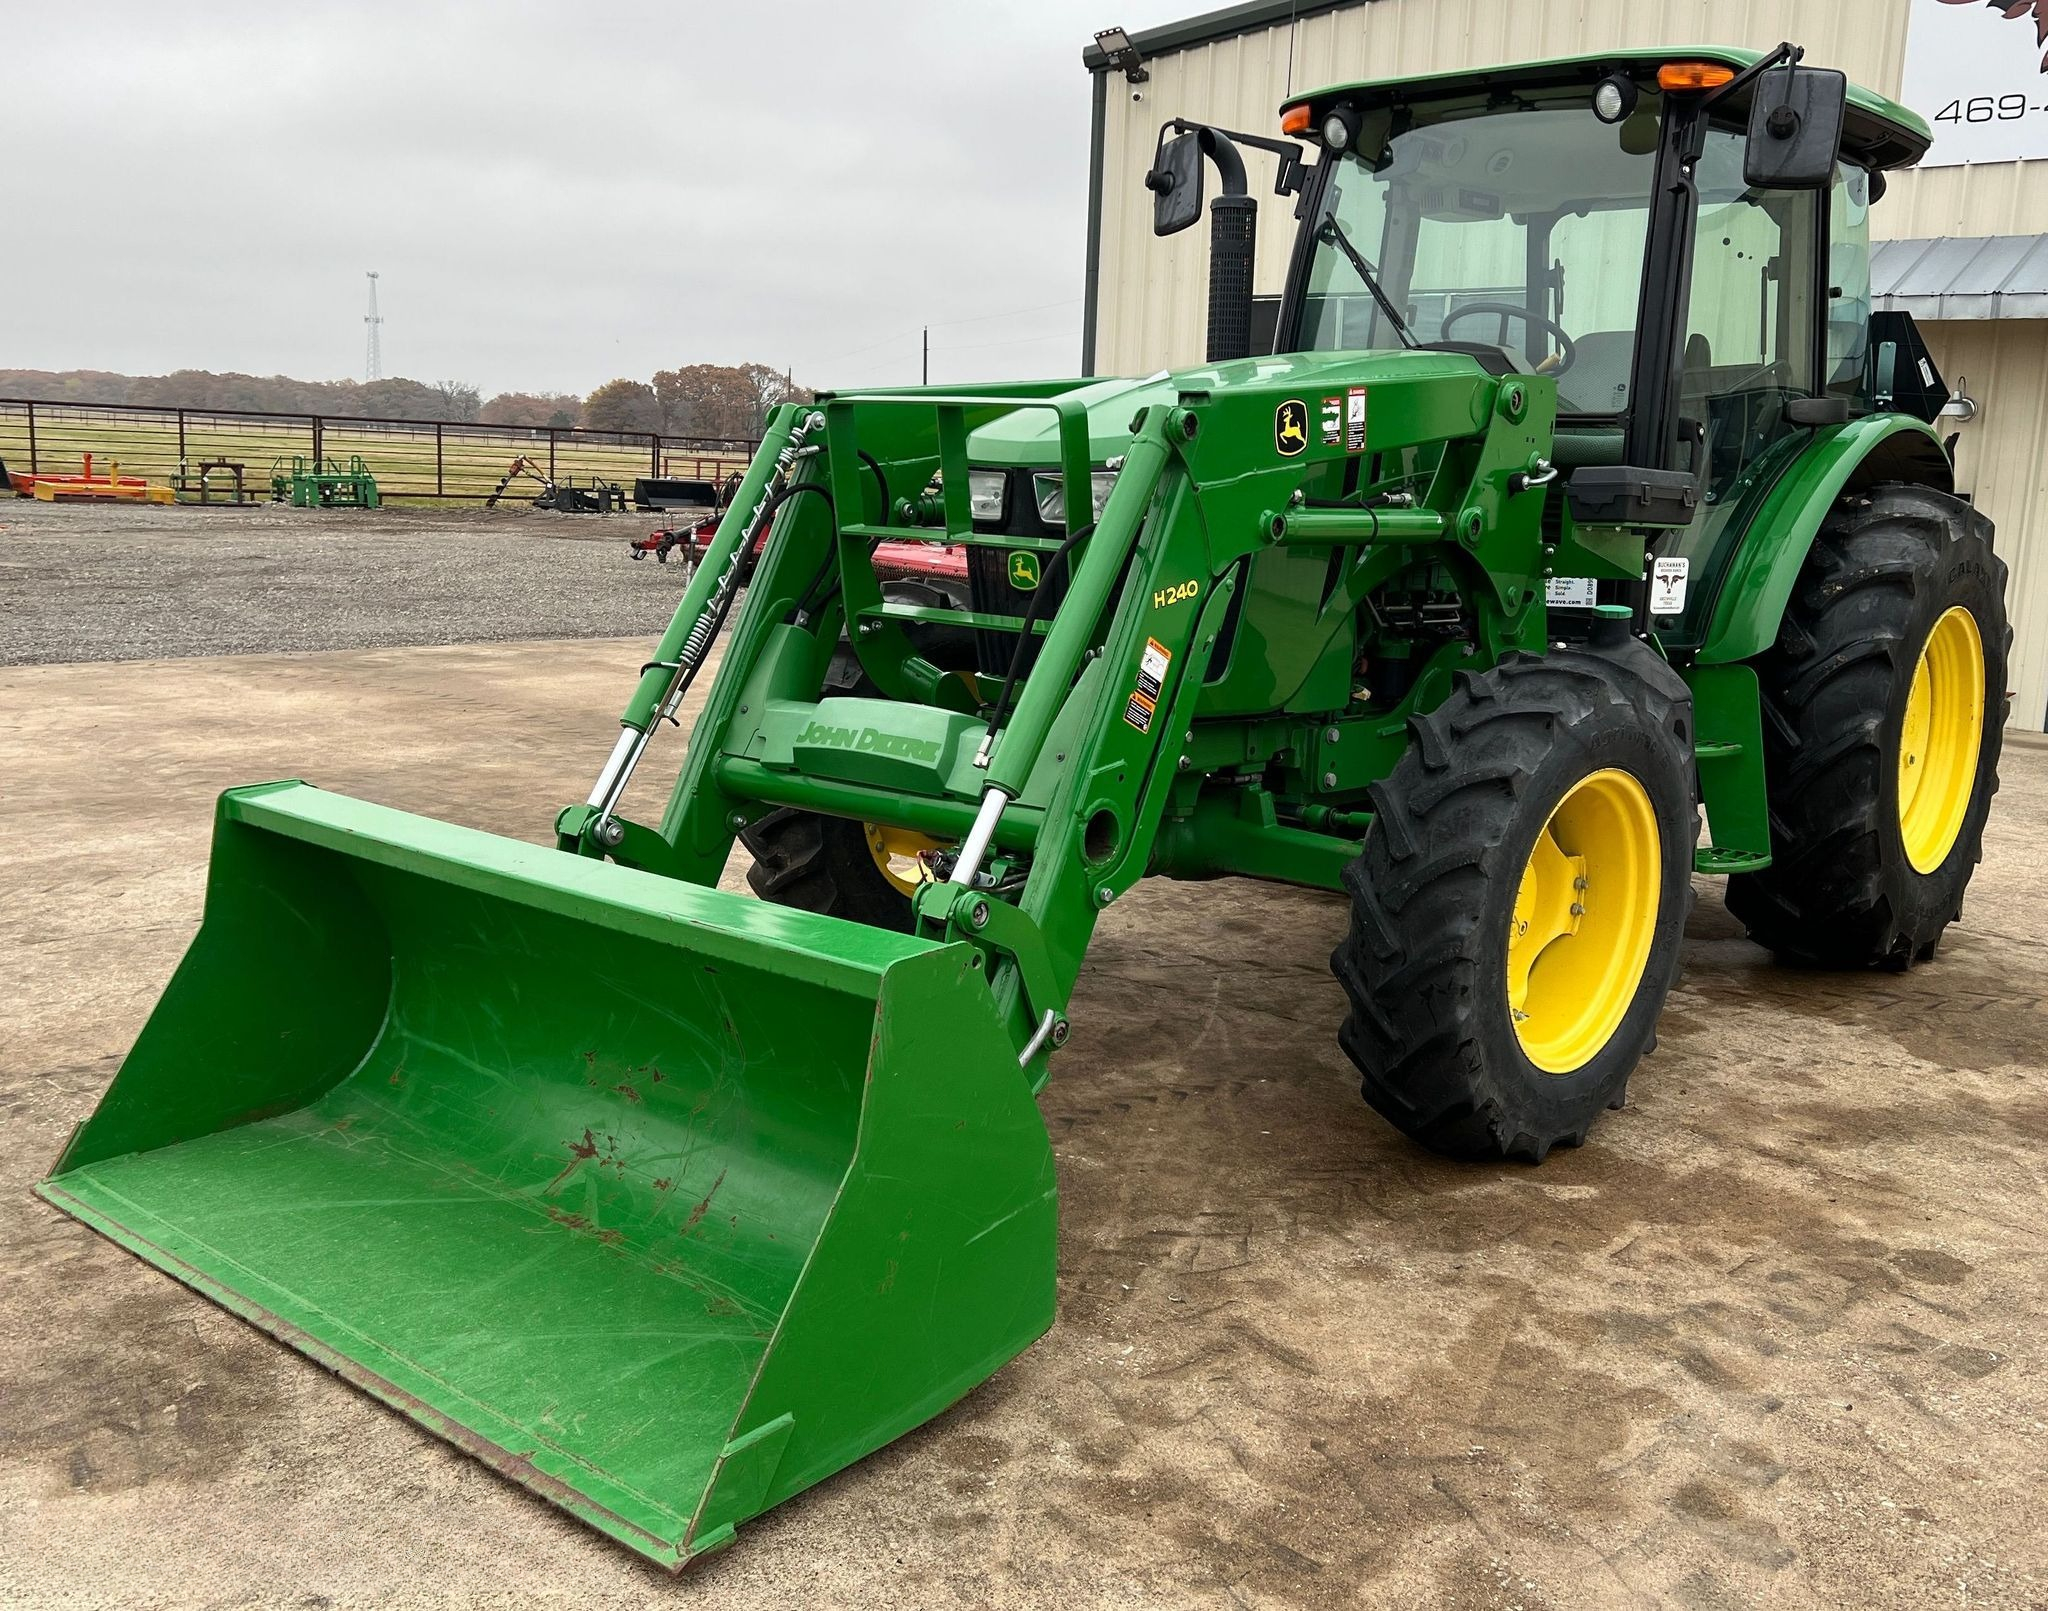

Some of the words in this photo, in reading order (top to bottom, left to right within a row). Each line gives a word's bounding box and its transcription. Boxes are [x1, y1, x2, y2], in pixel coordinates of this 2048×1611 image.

[1934, 94, 2048, 124] 469-
[1154, 579, 1199, 609] H240
[796, 722, 858, 749] JOHN
[855, 728, 941, 762] DEERE
